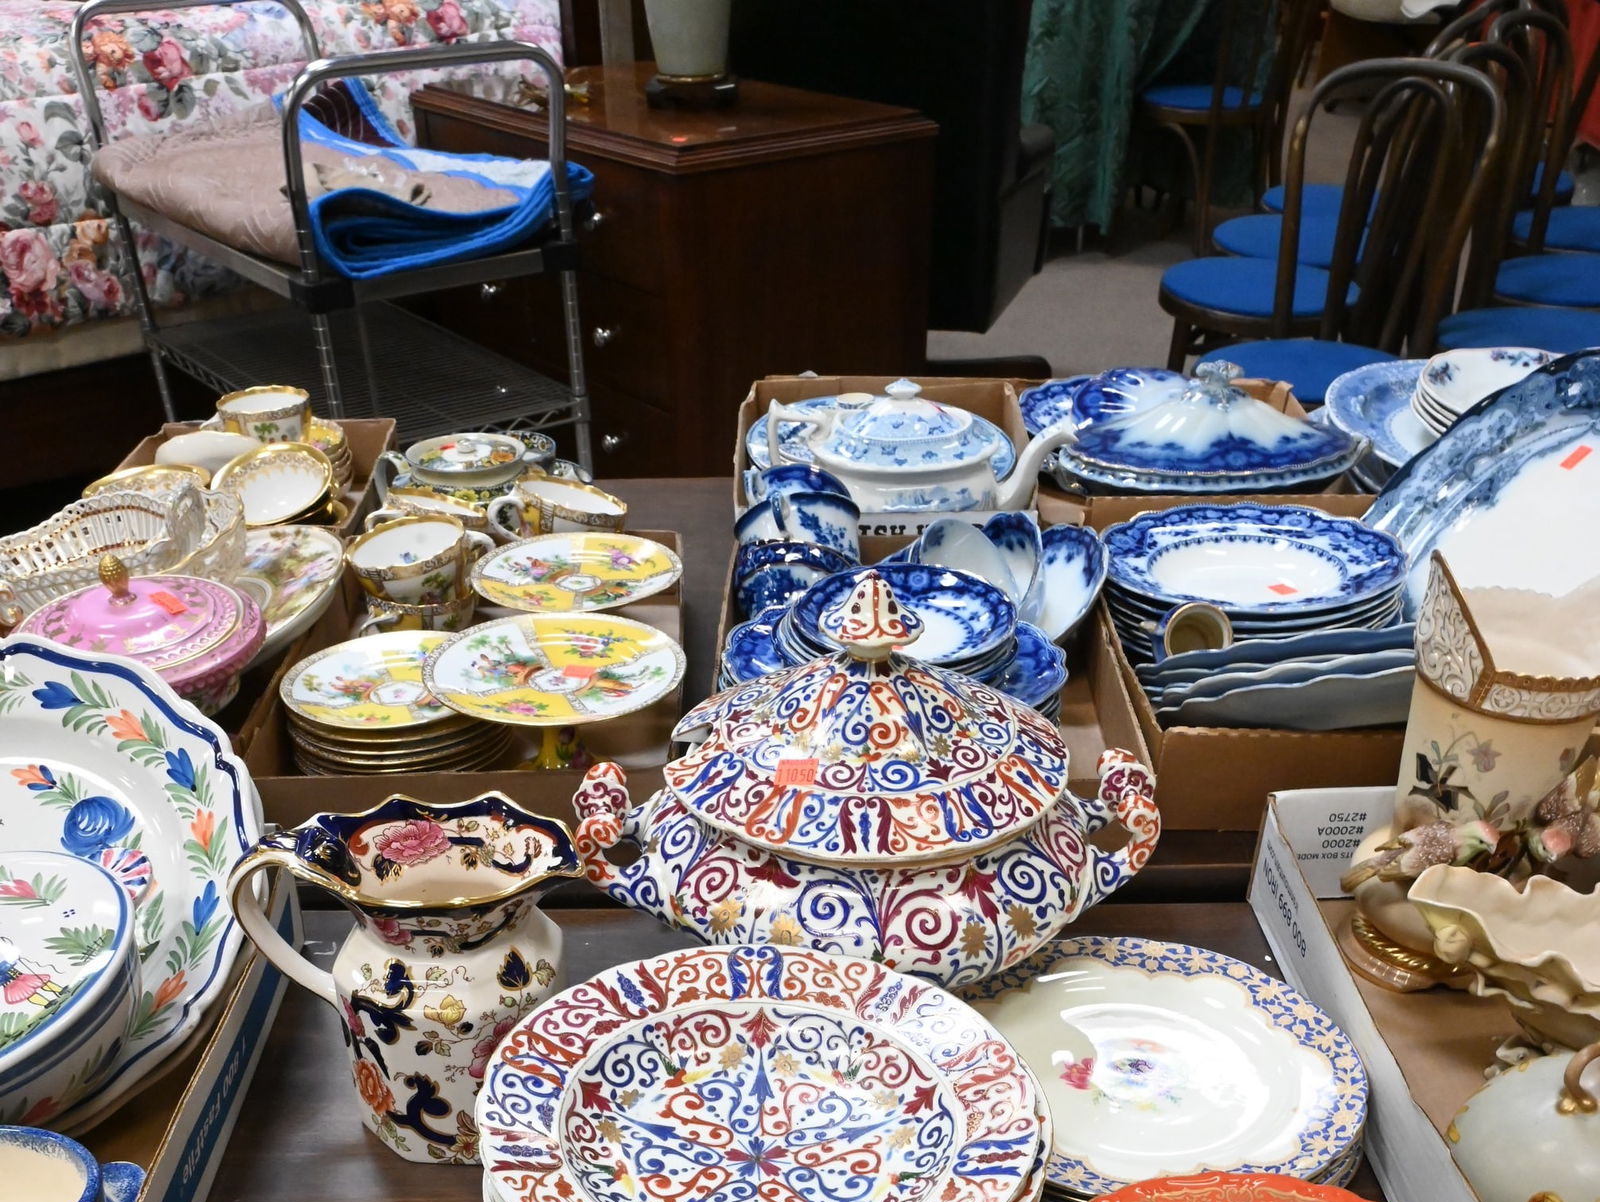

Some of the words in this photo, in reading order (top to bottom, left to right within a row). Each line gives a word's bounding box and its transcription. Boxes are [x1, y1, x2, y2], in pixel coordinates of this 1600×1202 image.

[1328, 812, 1367, 823] #2750
[1317, 826, 1364, 836] #2000A
[1322, 838, 1361, 849] #2000
[1263, 858, 1279, 899] IRON
[1278, 893, 1292, 927] 899
[1292, 921, 1307, 958] 800
